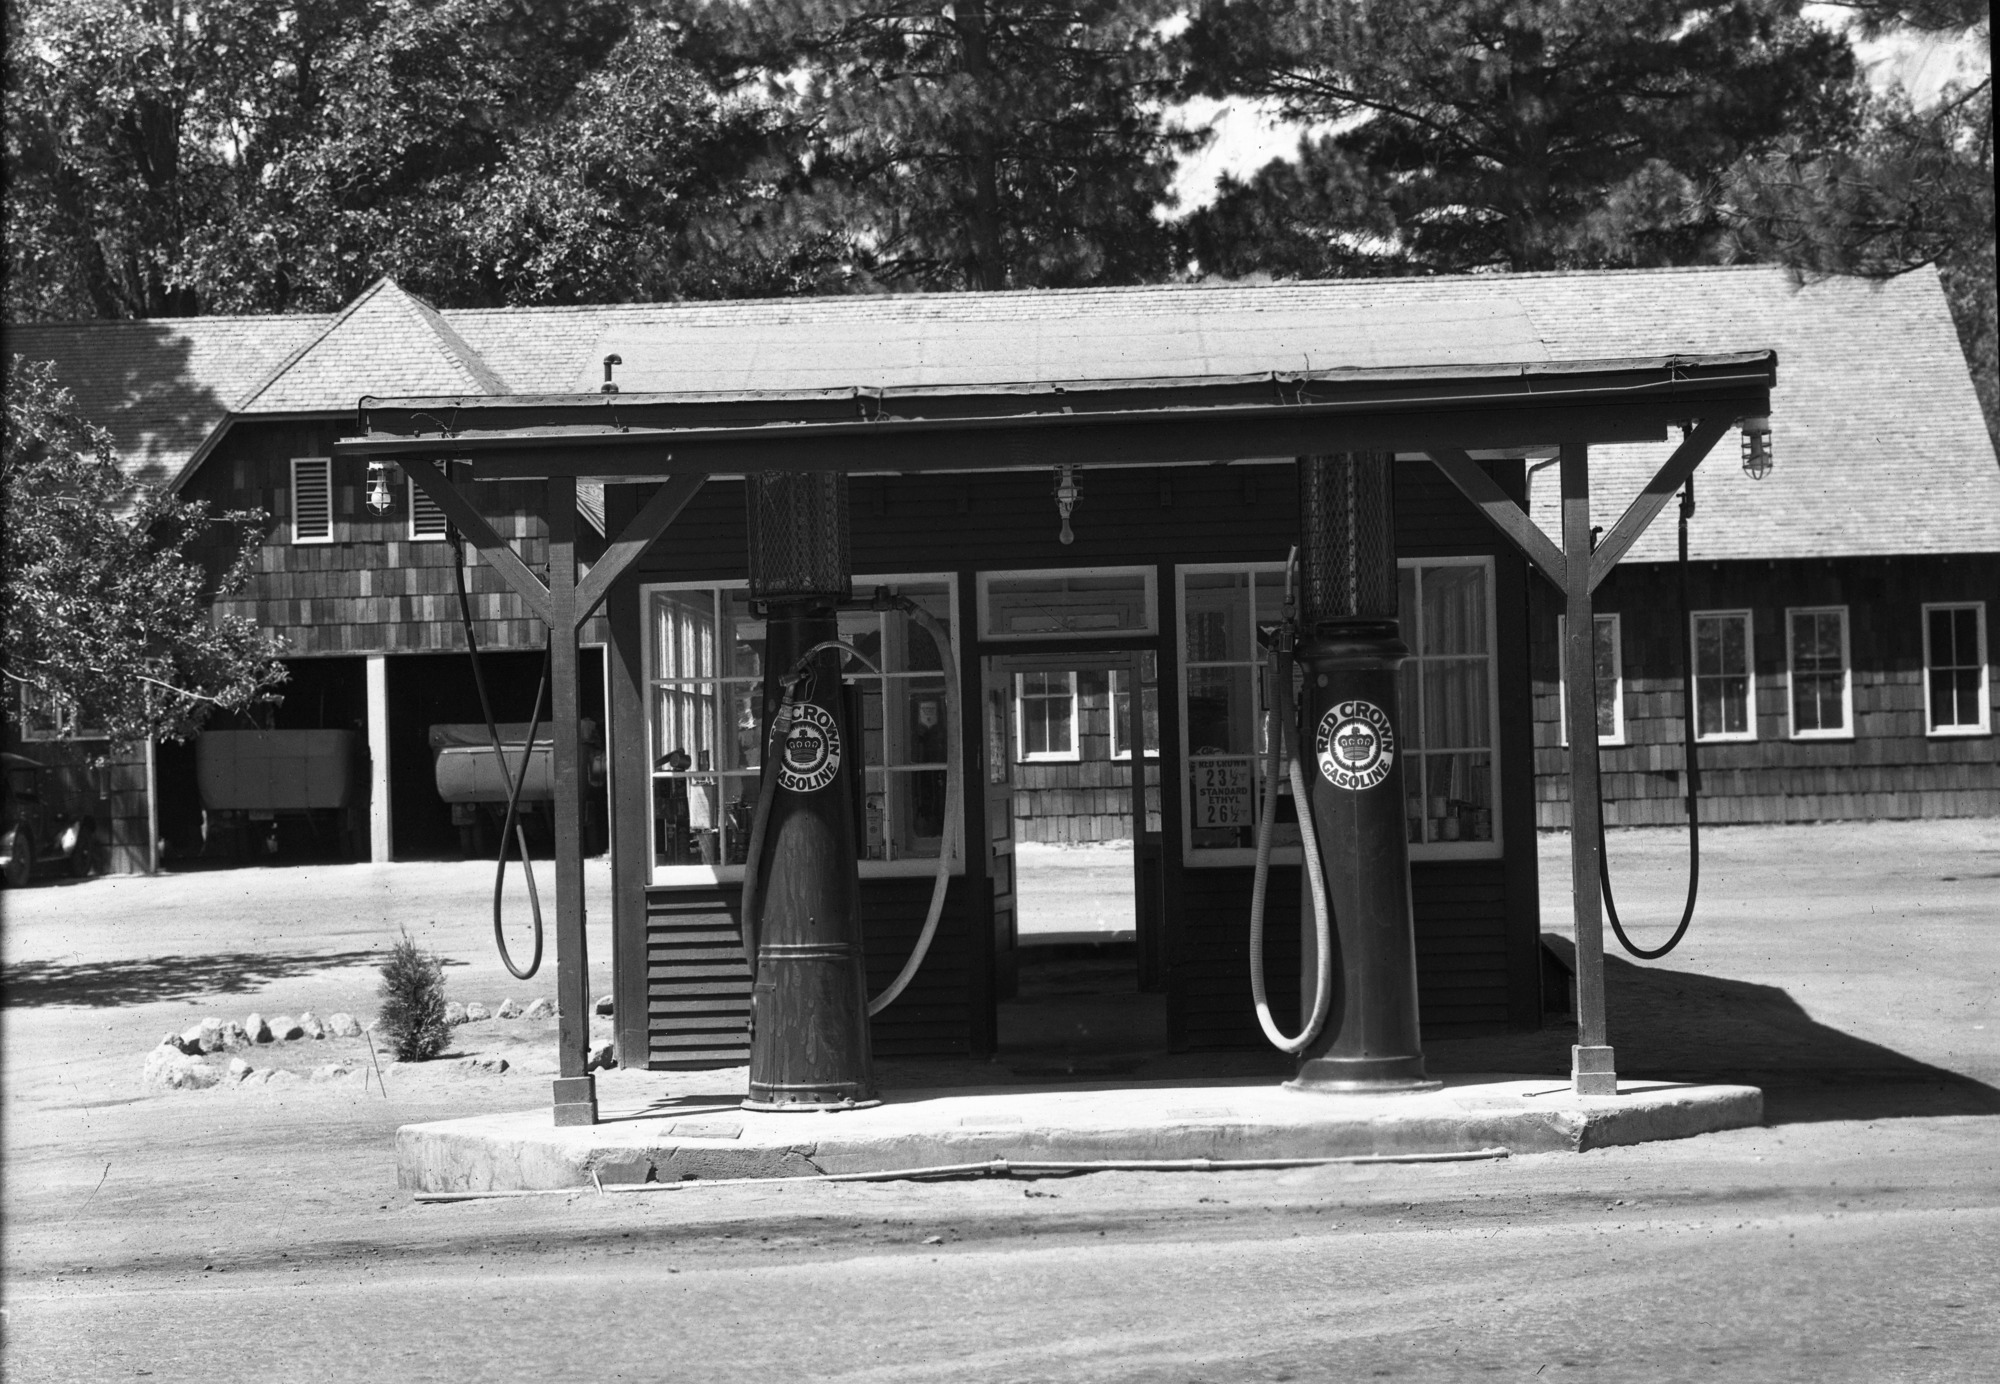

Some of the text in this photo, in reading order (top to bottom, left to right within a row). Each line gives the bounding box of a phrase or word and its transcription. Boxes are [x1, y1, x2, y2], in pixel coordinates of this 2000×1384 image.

[791, 705, 840, 757] CROWN
[1317, 702, 1393, 754] RED CROWN
[777, 762, 837, 791] ASOLINE
[1321, 759, 1391, 789] GASOLINE
[1200, 787, 1247, 796] STANDARD
[1209, 796, 1240, 804] ETHYL
